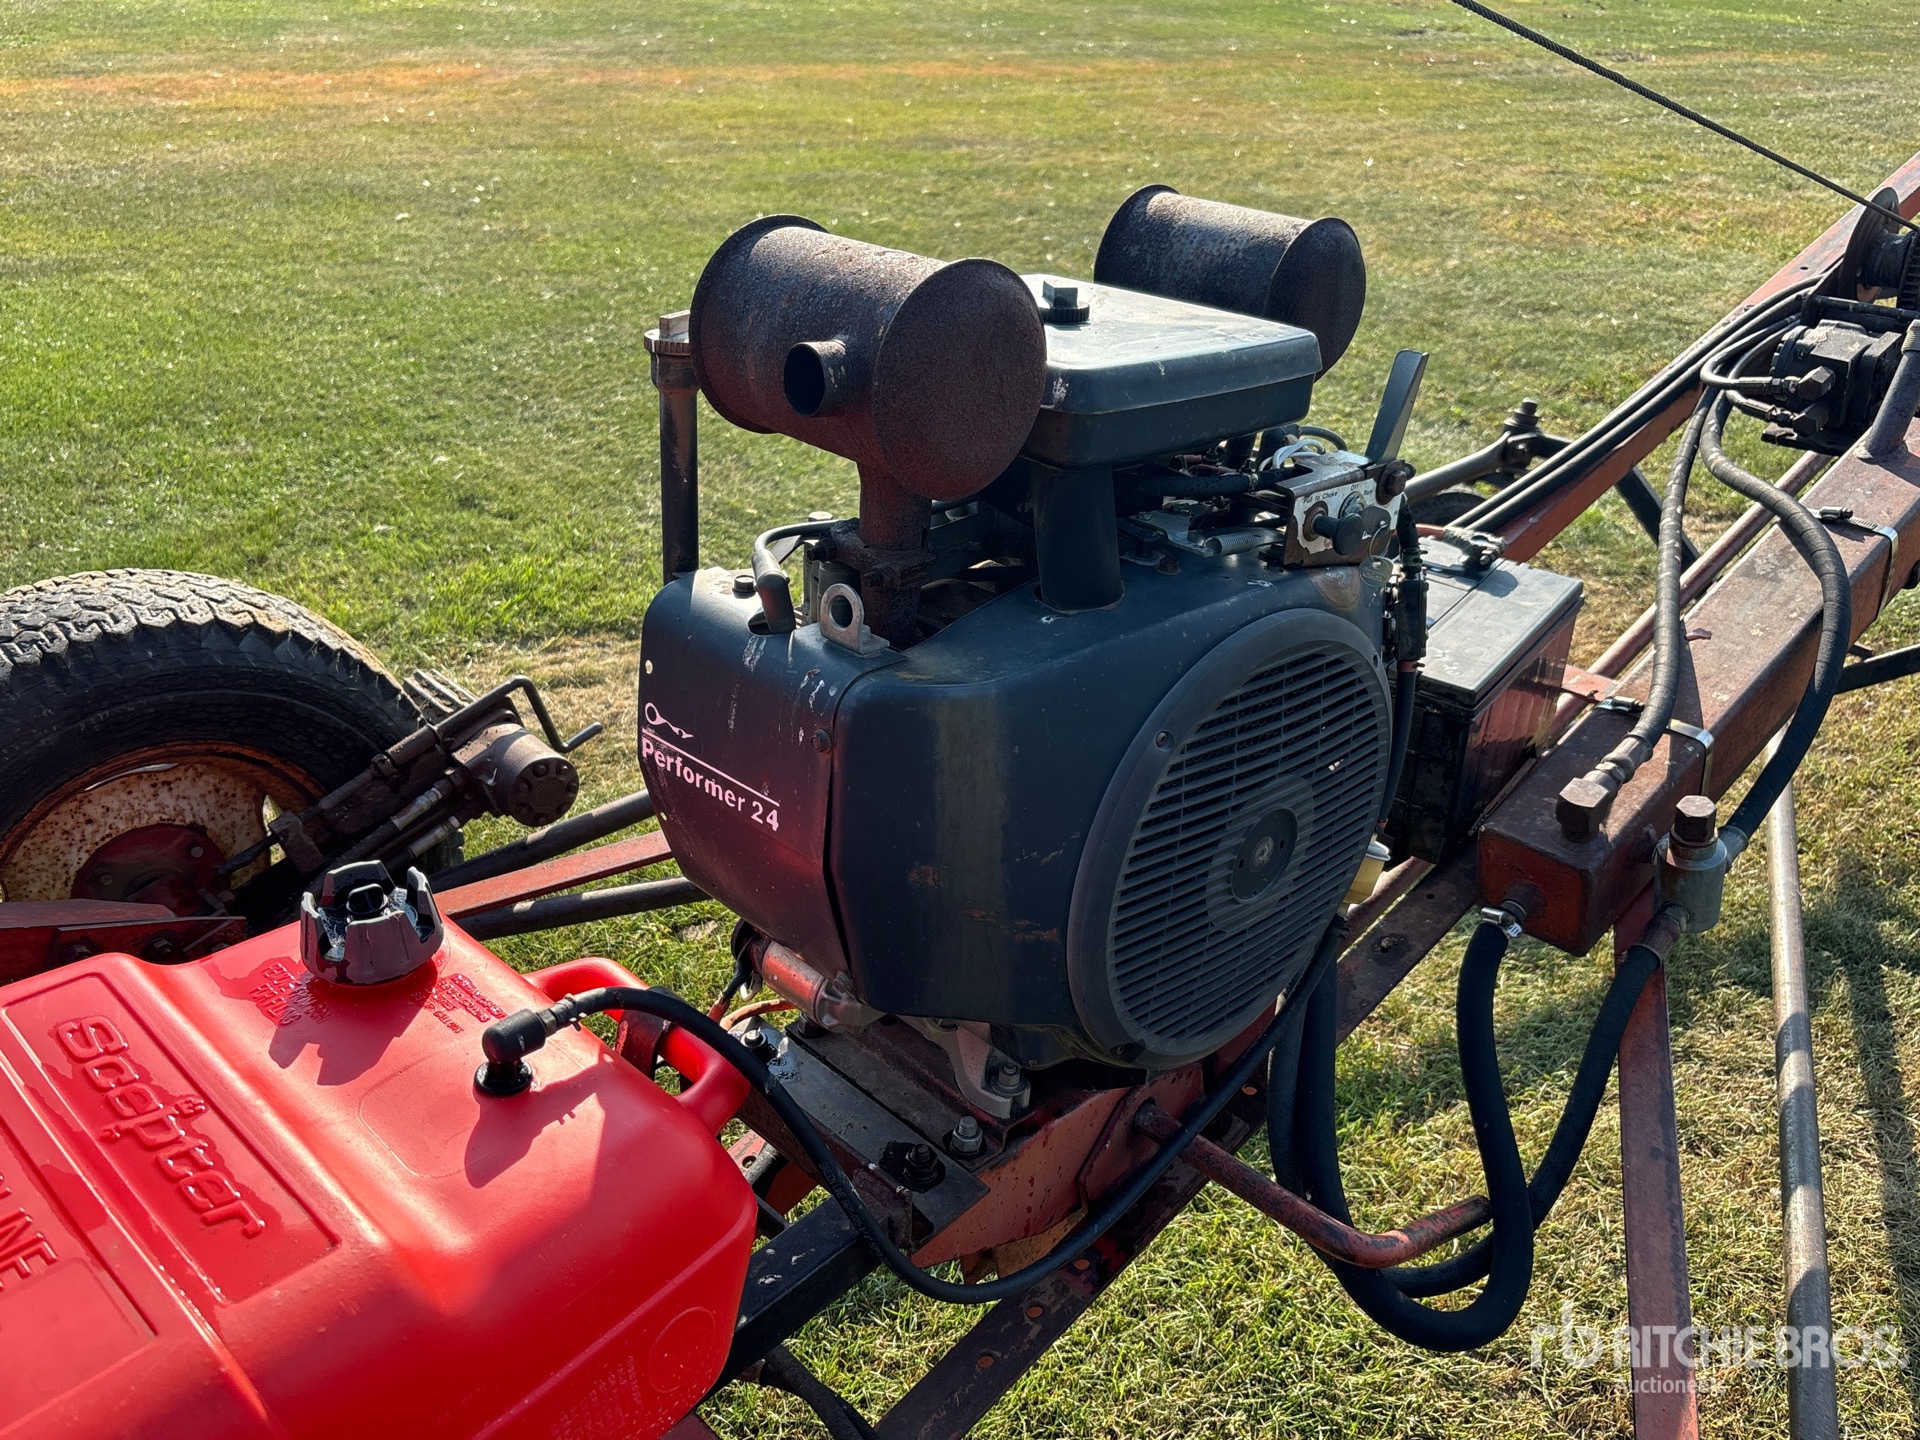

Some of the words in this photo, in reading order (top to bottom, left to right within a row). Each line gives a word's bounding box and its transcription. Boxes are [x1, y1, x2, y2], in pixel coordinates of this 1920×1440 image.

[1322, 491, 1338, 500] Choke
[641, 737, 745, 812] Performer
[751, 801, 779, 832] 24
[56, 1015, 265, 1240] Scepter
